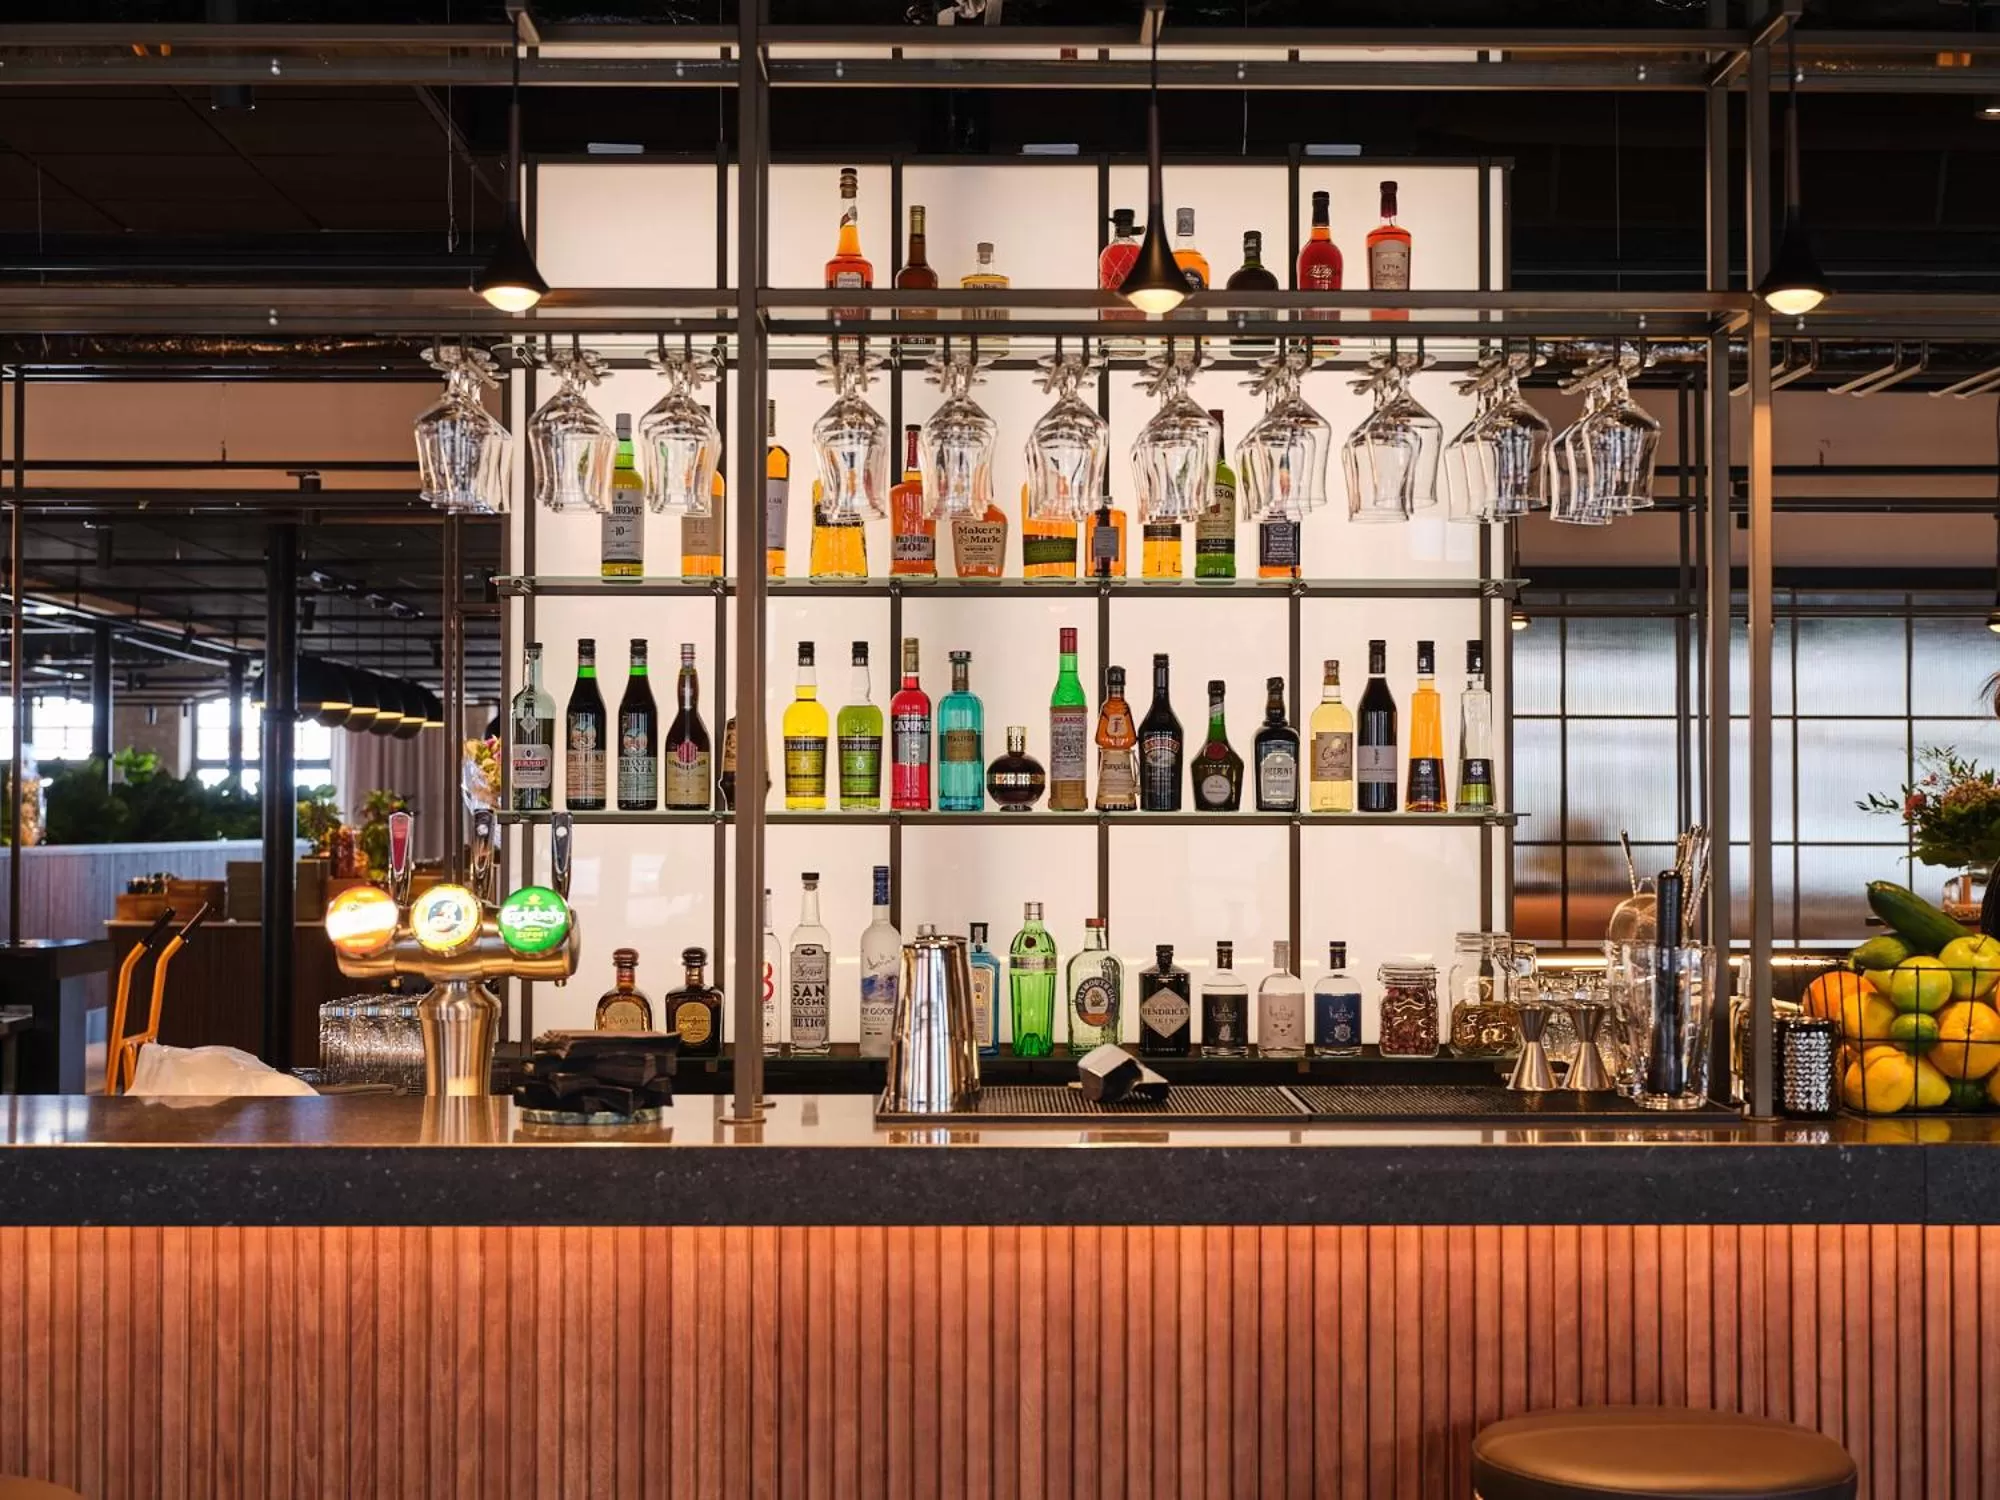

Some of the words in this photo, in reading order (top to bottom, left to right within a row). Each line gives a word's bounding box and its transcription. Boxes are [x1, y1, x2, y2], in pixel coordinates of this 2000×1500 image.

[958, 526, 1001, 534] Maker's
[970, 535, 1001, 544] Mark
[792, 984, 825, 998] SAN
[792, 998, 825, 1006] COSME
